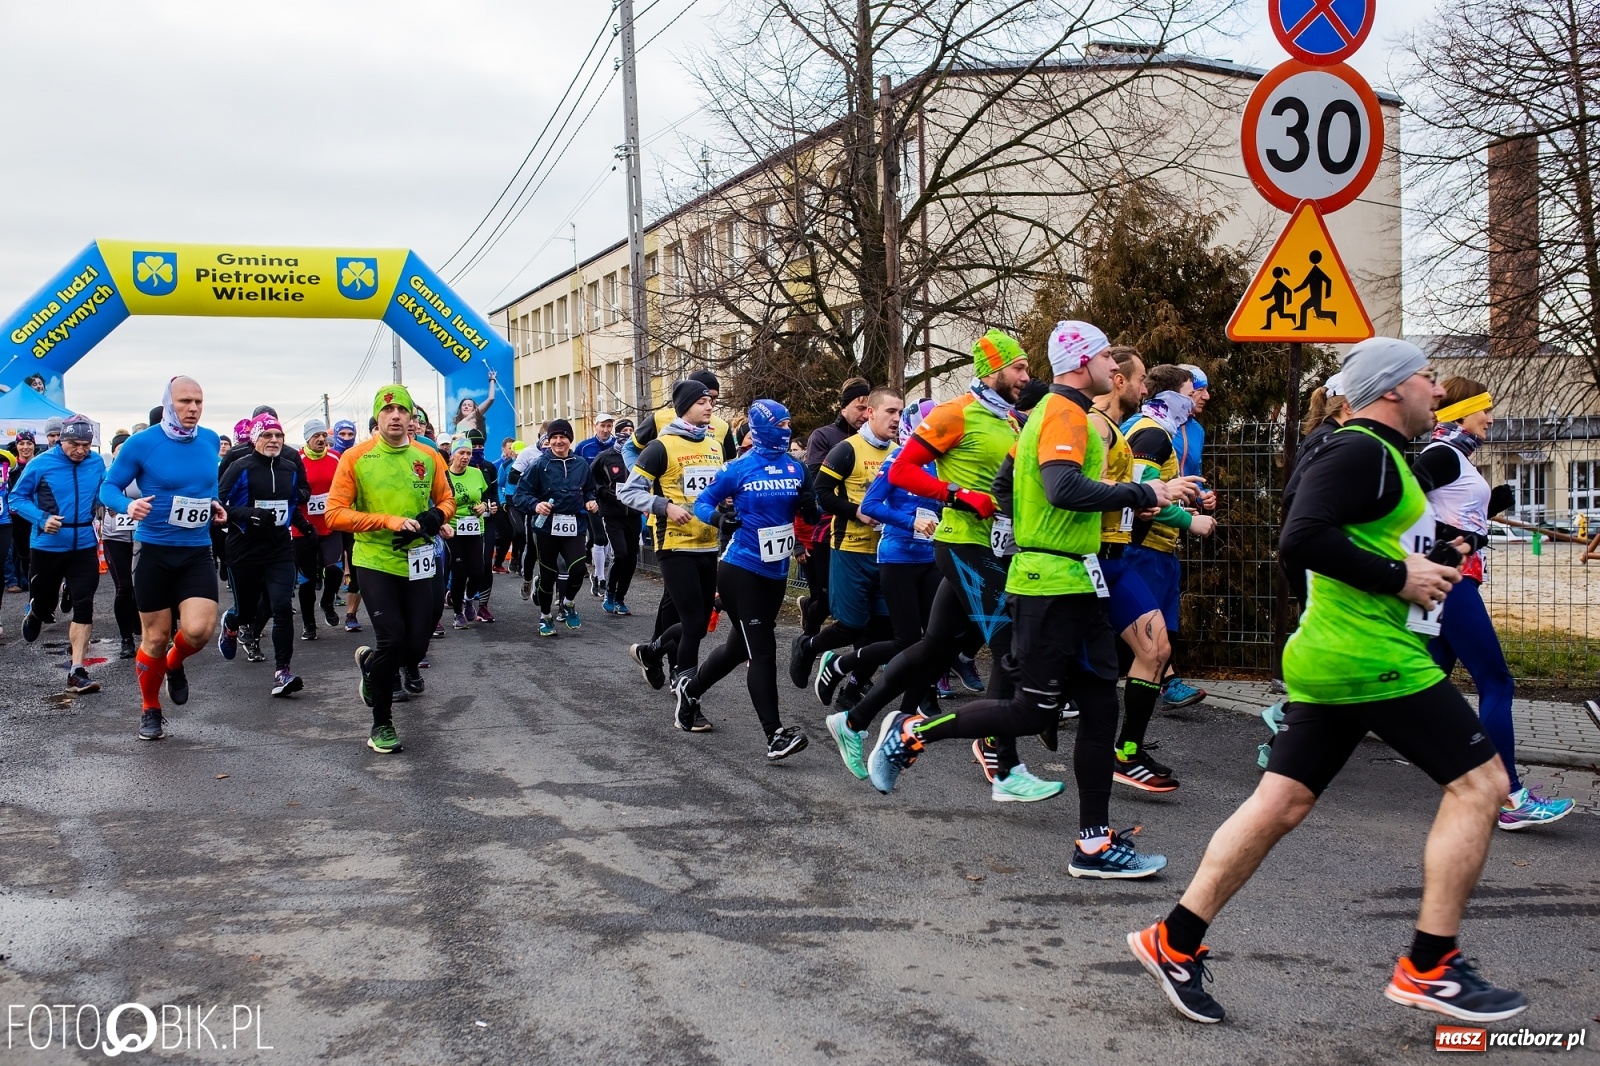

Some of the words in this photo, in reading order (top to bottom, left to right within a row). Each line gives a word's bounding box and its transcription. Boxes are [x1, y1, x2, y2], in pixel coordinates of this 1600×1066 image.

[1265, 96, 1362, 175] 30
[216, 253, 299, 267] Gmina
[195, 268, 321, 285] Pietrowice
[212, 286, 305, 302] Wielkie
[11, 301, 61, 344] Gmina
[56, 265, 99, 304] ludzi
[409, 275, 452, 319] Gmina
[451, 314, 489, 350] ludzi
[31, 284, 115, 359] aktywnych
[396, 292, 472, 363] aktywnych
[174, 507, 209, 523] 186
[458, 522, 480, 532] 462
[553, 522, 576, 533] 460
[763, 535, 794, 556] 170
